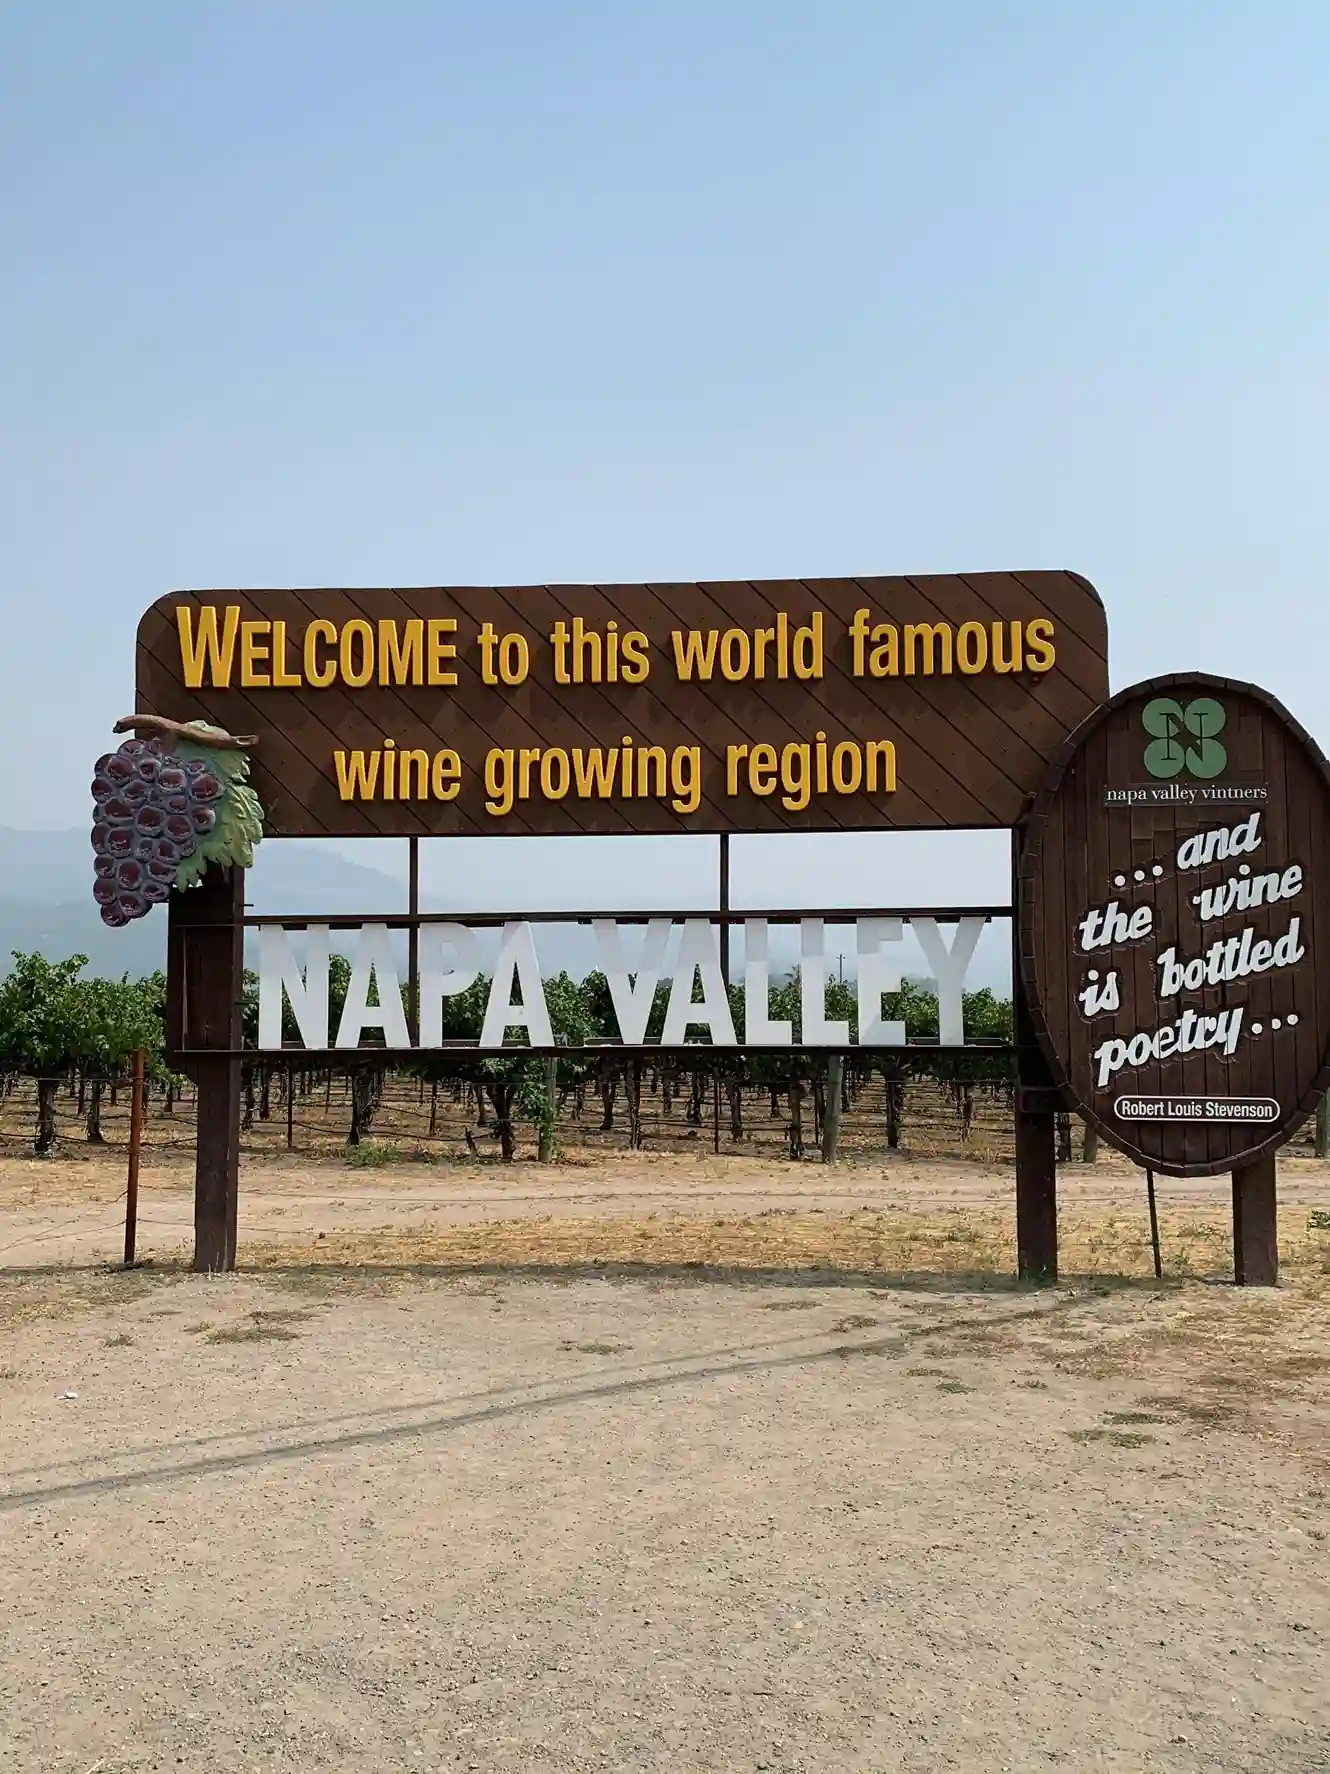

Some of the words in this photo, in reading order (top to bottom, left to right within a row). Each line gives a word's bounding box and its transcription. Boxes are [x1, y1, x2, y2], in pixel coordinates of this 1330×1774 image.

[176, 605, 458, 688] WELCOME
[478, 623, 529, 685] to
[550, 617, 650, 684] this
[672, 611, 824, 681] world
[849, 608, 1056, 678] famous
[334, 738, 462, 801] wine
[485, 735, 701, 816] growing
[727, 731, 896, 811] region
[1107, 789, 1148, 804] napa
[1151, 784, 1198, 802] valley
[1201, 784, 1268, 800] vintners
[1079, 901, 1153, 951] the
[1192, 864, 1303, 921] wine
[258, 921, 556, 1049] NAPA
[592, 917, 986, 1046] VALLEY
[1079, 969, 1120, 1017] is
[1157, 917, 1305, 997] bottled
[1121, 1101, 1165, 1115] Robert
[1168, 1101, 1202, 1116] Louis
[1205, 1102, 1273, 1118] Stevenson
